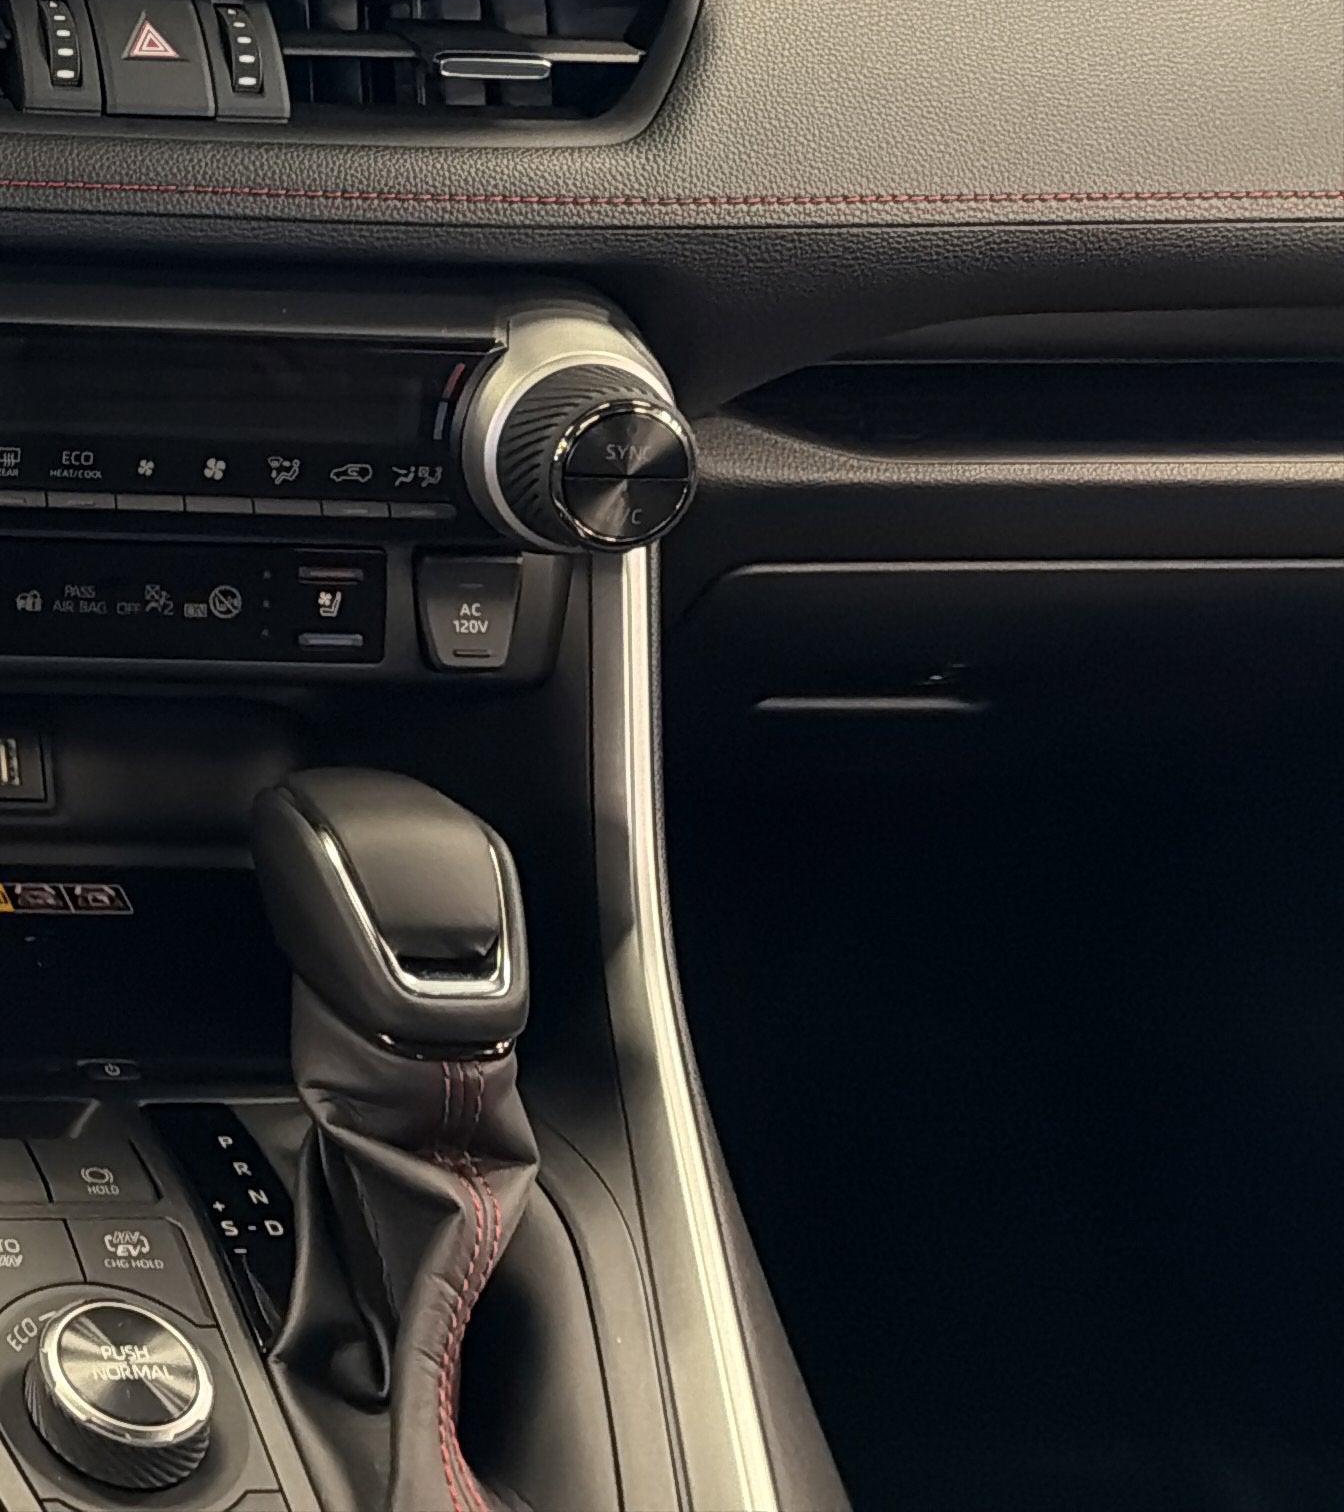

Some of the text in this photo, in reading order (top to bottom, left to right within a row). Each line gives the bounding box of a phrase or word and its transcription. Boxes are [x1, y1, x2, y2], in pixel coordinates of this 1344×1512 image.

[62, 451, 94, 466] ECO
[64, 585, 96, 598] PASS
[52, 601, 74, 613] AIR
[79, 601, 108, 614] BAG
[459, 602, 482, 617] AC
[452, 619, 489, 634] 120V
[218, 1135, 233, 1149] P
[232, 1161, 252, 1176] R
[88, 1185, 120, 1196] HOLD
[247, 1189, 269, 1205] N
[220, 1220, 239, 1236] S
[264, 1219, 284, 1236] D
[116, 1244, 141, 1257] EV
[131, 1258, 164, 1269] HOLD
[6, 1316, 38, 1352] ECO
[99, 1345, 150, 1361] PUSH
[92, 1364, 174, 1382] NORMAL
